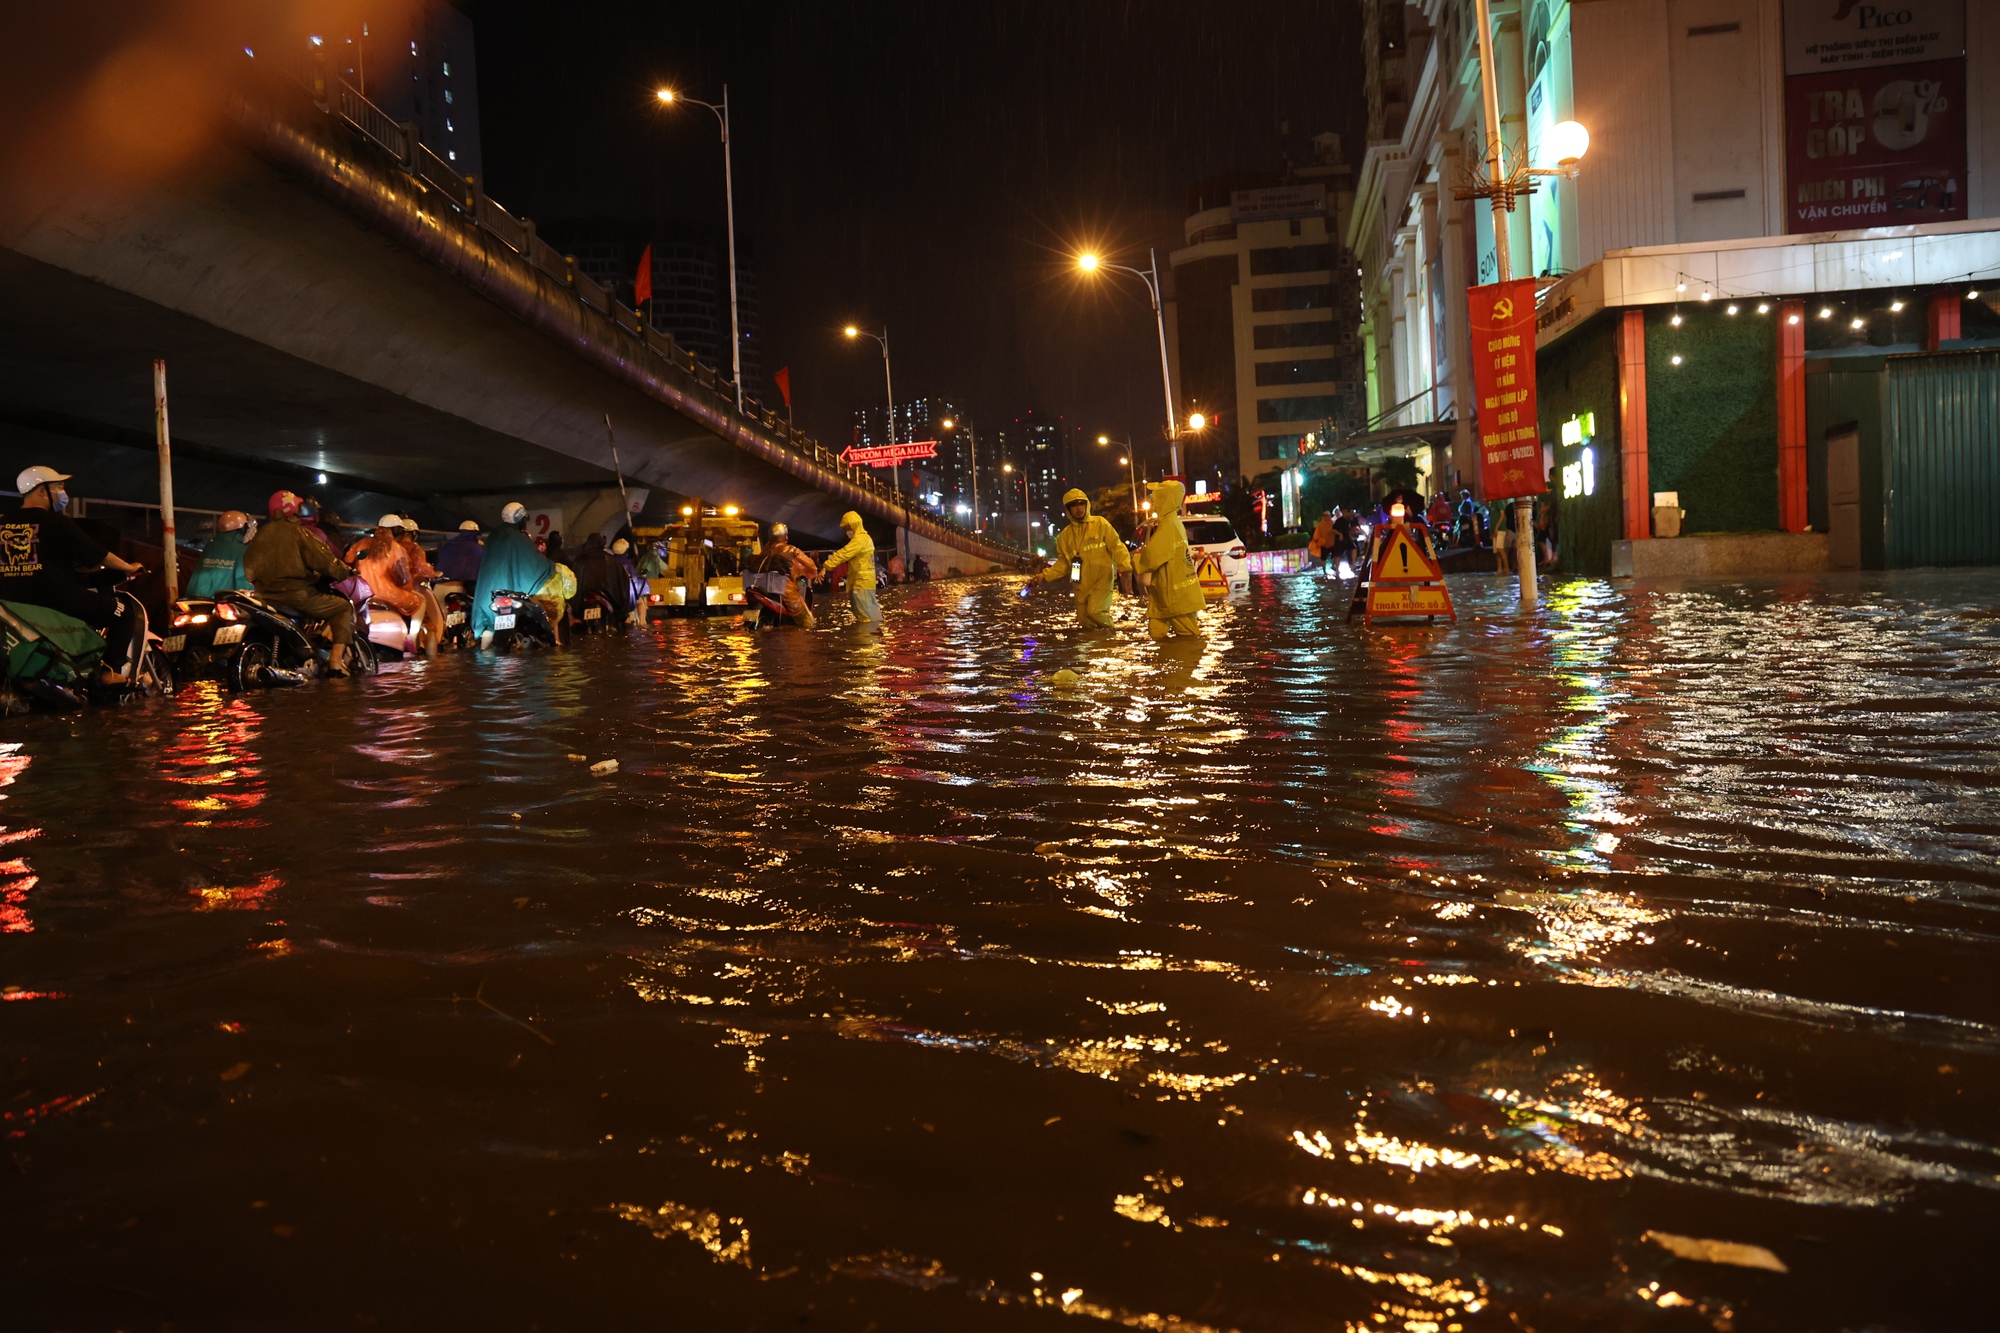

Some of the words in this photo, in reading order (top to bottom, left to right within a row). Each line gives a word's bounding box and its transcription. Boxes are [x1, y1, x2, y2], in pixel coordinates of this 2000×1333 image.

[1806, 122, 1867, 159] GÓP
[1797, 207, 1827, 221] VẬN
[1517, 388, 1528, 404] LẬP
[849, 450, 881, 461] VINCOM
[883, 448, 906, 458] MEGA
[907, 445, 930, 455] MALL
[1184, 492, 1221, 504] AGRIBANK
[22, 563, 43, 572] BEAR
[1375, 602, 1400, 610] THOÁT
